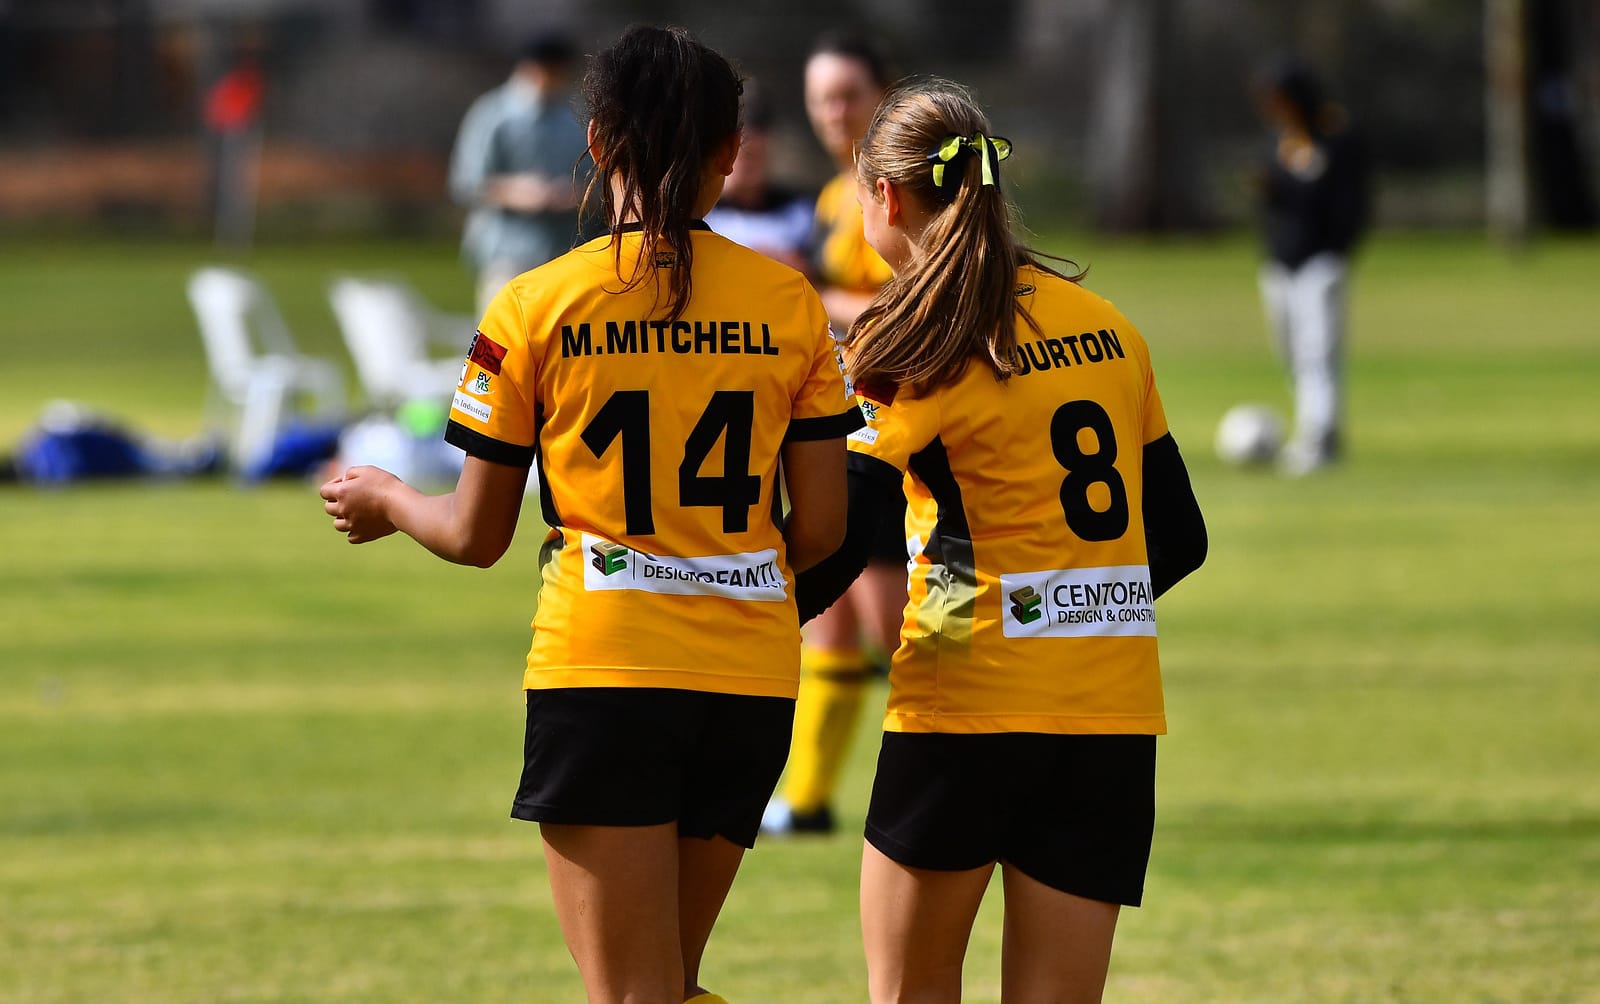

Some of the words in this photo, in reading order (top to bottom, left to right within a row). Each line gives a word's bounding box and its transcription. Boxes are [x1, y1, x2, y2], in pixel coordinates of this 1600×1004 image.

[561, 320, 779, 358] M.MITCHELL
[478, 371, 491, 383] BV
[580, 390, 761, 536] 14
[1050, 400, 1129, 542] 8
[1057, 610, 1103, 624] DESIGN
[1106, 609, 1116, 622] &
